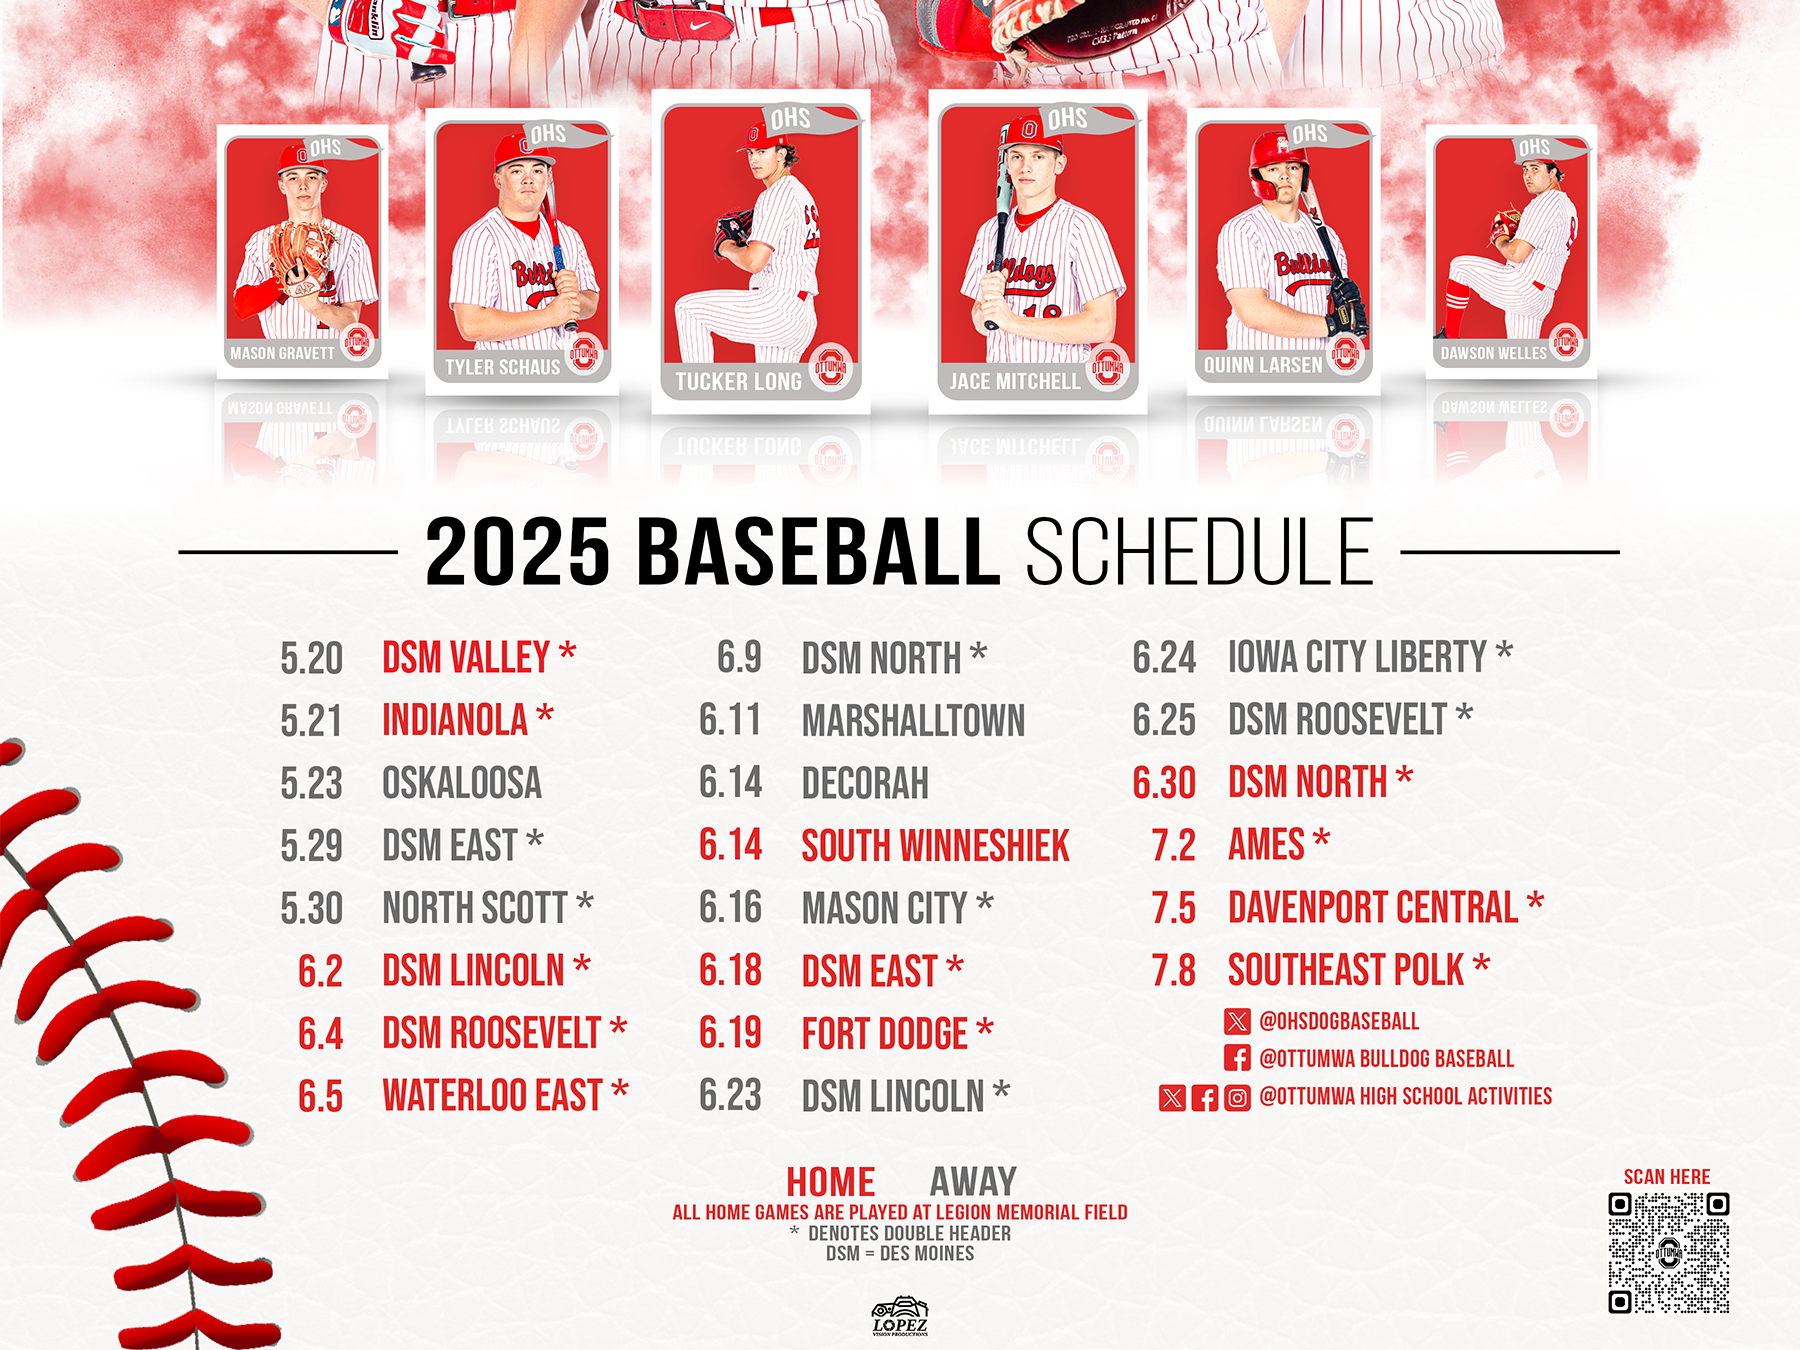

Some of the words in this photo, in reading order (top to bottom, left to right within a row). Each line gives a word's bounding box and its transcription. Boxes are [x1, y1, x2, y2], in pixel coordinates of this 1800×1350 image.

[531, 123, 567, 145] OHS
[772, 106, 811, 131] OHS
[1048, 106, 1088, 131] OHS
[1292, 123, 1328, 145] OHS
[310, 137, 342, 157] OHS
[1519, 137, 1551, 156] OHS
[231, 346, 275, 360] MASON
[279, 346, 335, 360] GRAVETT
[445, 358, 494, 375] TYLER
[499, 358, 561, 375] SCHAUS
[1204, 356, 1254, 374] QUINN
[1260, 356, 1323, 374] LARSEN
[1441, 346, 1494, 360] DAWSON
[1498, 346, 1547, 360] WELLES
[675, 372, 748, 391] TUCKER
[755, 372, 802, 391] LONG
[949, 372, 991, 390] JACE
[996, 372, 1081, 390] MITCHELL
[427, 516, 608, 586] 2025
[639, 516, 1000, 586] BASEBALL
[1027, 516, 1373, 585] SCHEDULE
[282, 641, 342, 674] 5.20
[384, 640, 440, 673] DSM
[450, 640, 550, 673] VALLEY
[719, 640, 760, 672] 6.9
[803, 641, 860, 674] DSM
[872, 641, 960, 674] NORTH
[1134, 640, 1196, 673] 6.24
[1230, 640, 1298, 672] IOWA
[1307, 640, 1366, 672] CITY
[1377, 640, 1487, 672] LIBERTY
[282, 704, 339, 736] 5.21
[384, 702, 528, 736] INDIANOLA
[701, 702, 758, 735] 6.11
[804, 704, 1024, 736] MARSHALLTOWN
[1134, 703, 1195, 735] 6.25
[1230, 702, 1286, 735] DSM
[1297, 702, 1447, 735] ROOSEVELT
[282, 766, 341, 799] 5.23
[384, 766, 542, 798] OSKALOOSA
[701, 765, 762, 797] 6.14
[803, 766, 928, 799] DECORAH
[1134, 765, 1195, 799] 6.30
[1230, 764, 1286, 798] DSM
[1297, 764, 1386, 798] NORTH
[282, 829, 341, 861] 5.29
[384, 828, 440, 861] DSM
[451, 828, 518, 861] EAST
[700, 827, 762, 860] 6.14
[802, 828, 890, 862] SOUTH
[900, 828, 1070, 862] WINNESHIEK
[1152, 828, 1195, 861] 7.2
[1228, 827, 1304, 860] AMES
[282, 891, 342, 924] 5.30
[384, 891, 472, 923] NORTH
[483, 891, 568, 923] SCOTT
[701, 890, 761, 922] 6.16
[803, 891, 898, 924] MASON
[909, 891, 967, 924] CITY
[1152, 891, 1195, 924] 7.5
[1230, 890, 1388, 923] DAVENPORT
[1397, 890, 1518, 923] CENTRAL
[299, 954, 342, 987] 6.2
[384, 953, 440, 986] DSM
[451, 953, 563, 986] LINCOLN
[700, 952, 761, 986] 6.18
[803, 954, 860, 987] DSM
[871, 954, 938, 987] EAST
[1152, 953, 1195, 986] 7.8
[1229, 952, 1386, 986] SOUTHEAST
[1395, 952, 1464, 986] POLK
[299, 1016, 343, 1050] 6.4
[384, 1015, 440, 1049] DSM
[451, 1015, 601, 1049] ROOSEVELT
[700, 1015, 761, 1048] 6.19
[803, 1016, 870, 1050] FORT
[880, 1016, 967, 1050] DODGE
[1260, 1011, 1419, 1031] @OHSDOGBASEBALL
[1260, 1048, 1355, 1069] @OTTUMWA
[1361, 1049, 1429, 1067] BULLDOG
[1436, 1049, 1514, 1067] BASEBALL
[299, 1079, 342, 1112] 6.5
[383, 1078, 526, 1111] WATERLOO
[536, 1078, 603, 1111] EAST
[701, 1078, 760, 1110] 6.23
[804, 1079, 860, 1112] DSM
[871, 1079, 983, 1112] LINCOLN
[1260, 1086, 1355, 1106] @OTTUMWA
[1361, 1087, 1396, 1105] HIGH
[1403, 1087, 1462, 1105] SCHOOL
[1468, 1087, 1552, 1105] ACTIVITIES
[788, 1166, 875, 1197] HOME
[930, 1166, 1017, 1196] AWAY
[1625, 1169, 1664, 1184] SCAN
[1671, 1169, 1710, 1184] HERE
[673, 1204, 700, 1220] ALL
[706, 1204, 750, 1220] HOME
[756, 1204, 808, 1220] GAMES
[814, 1204, 844, 1220] ARE
[850, 1204, 907, 1220] PLAYED
[913, 1204, 931, 1220] AT
[937, 1204, 990, 1220] LEGION
[997, 1204, 1079, 1220] MEMORIAL
[1085, 1204, 1127, 1220] FIELD
[809, 1225, 878, 1241] DENOTES
[885, 1225, 944, 1240] DOUBLE
[950, 1225, 1010, 1241] HEADER
[827, 1245, 859, 1261] DSM
[881, 1245, 909, 1261] DES
[915, 1245, 974, 1261] MOINES
[872, 1319, 928, 1332] LOPEZ
